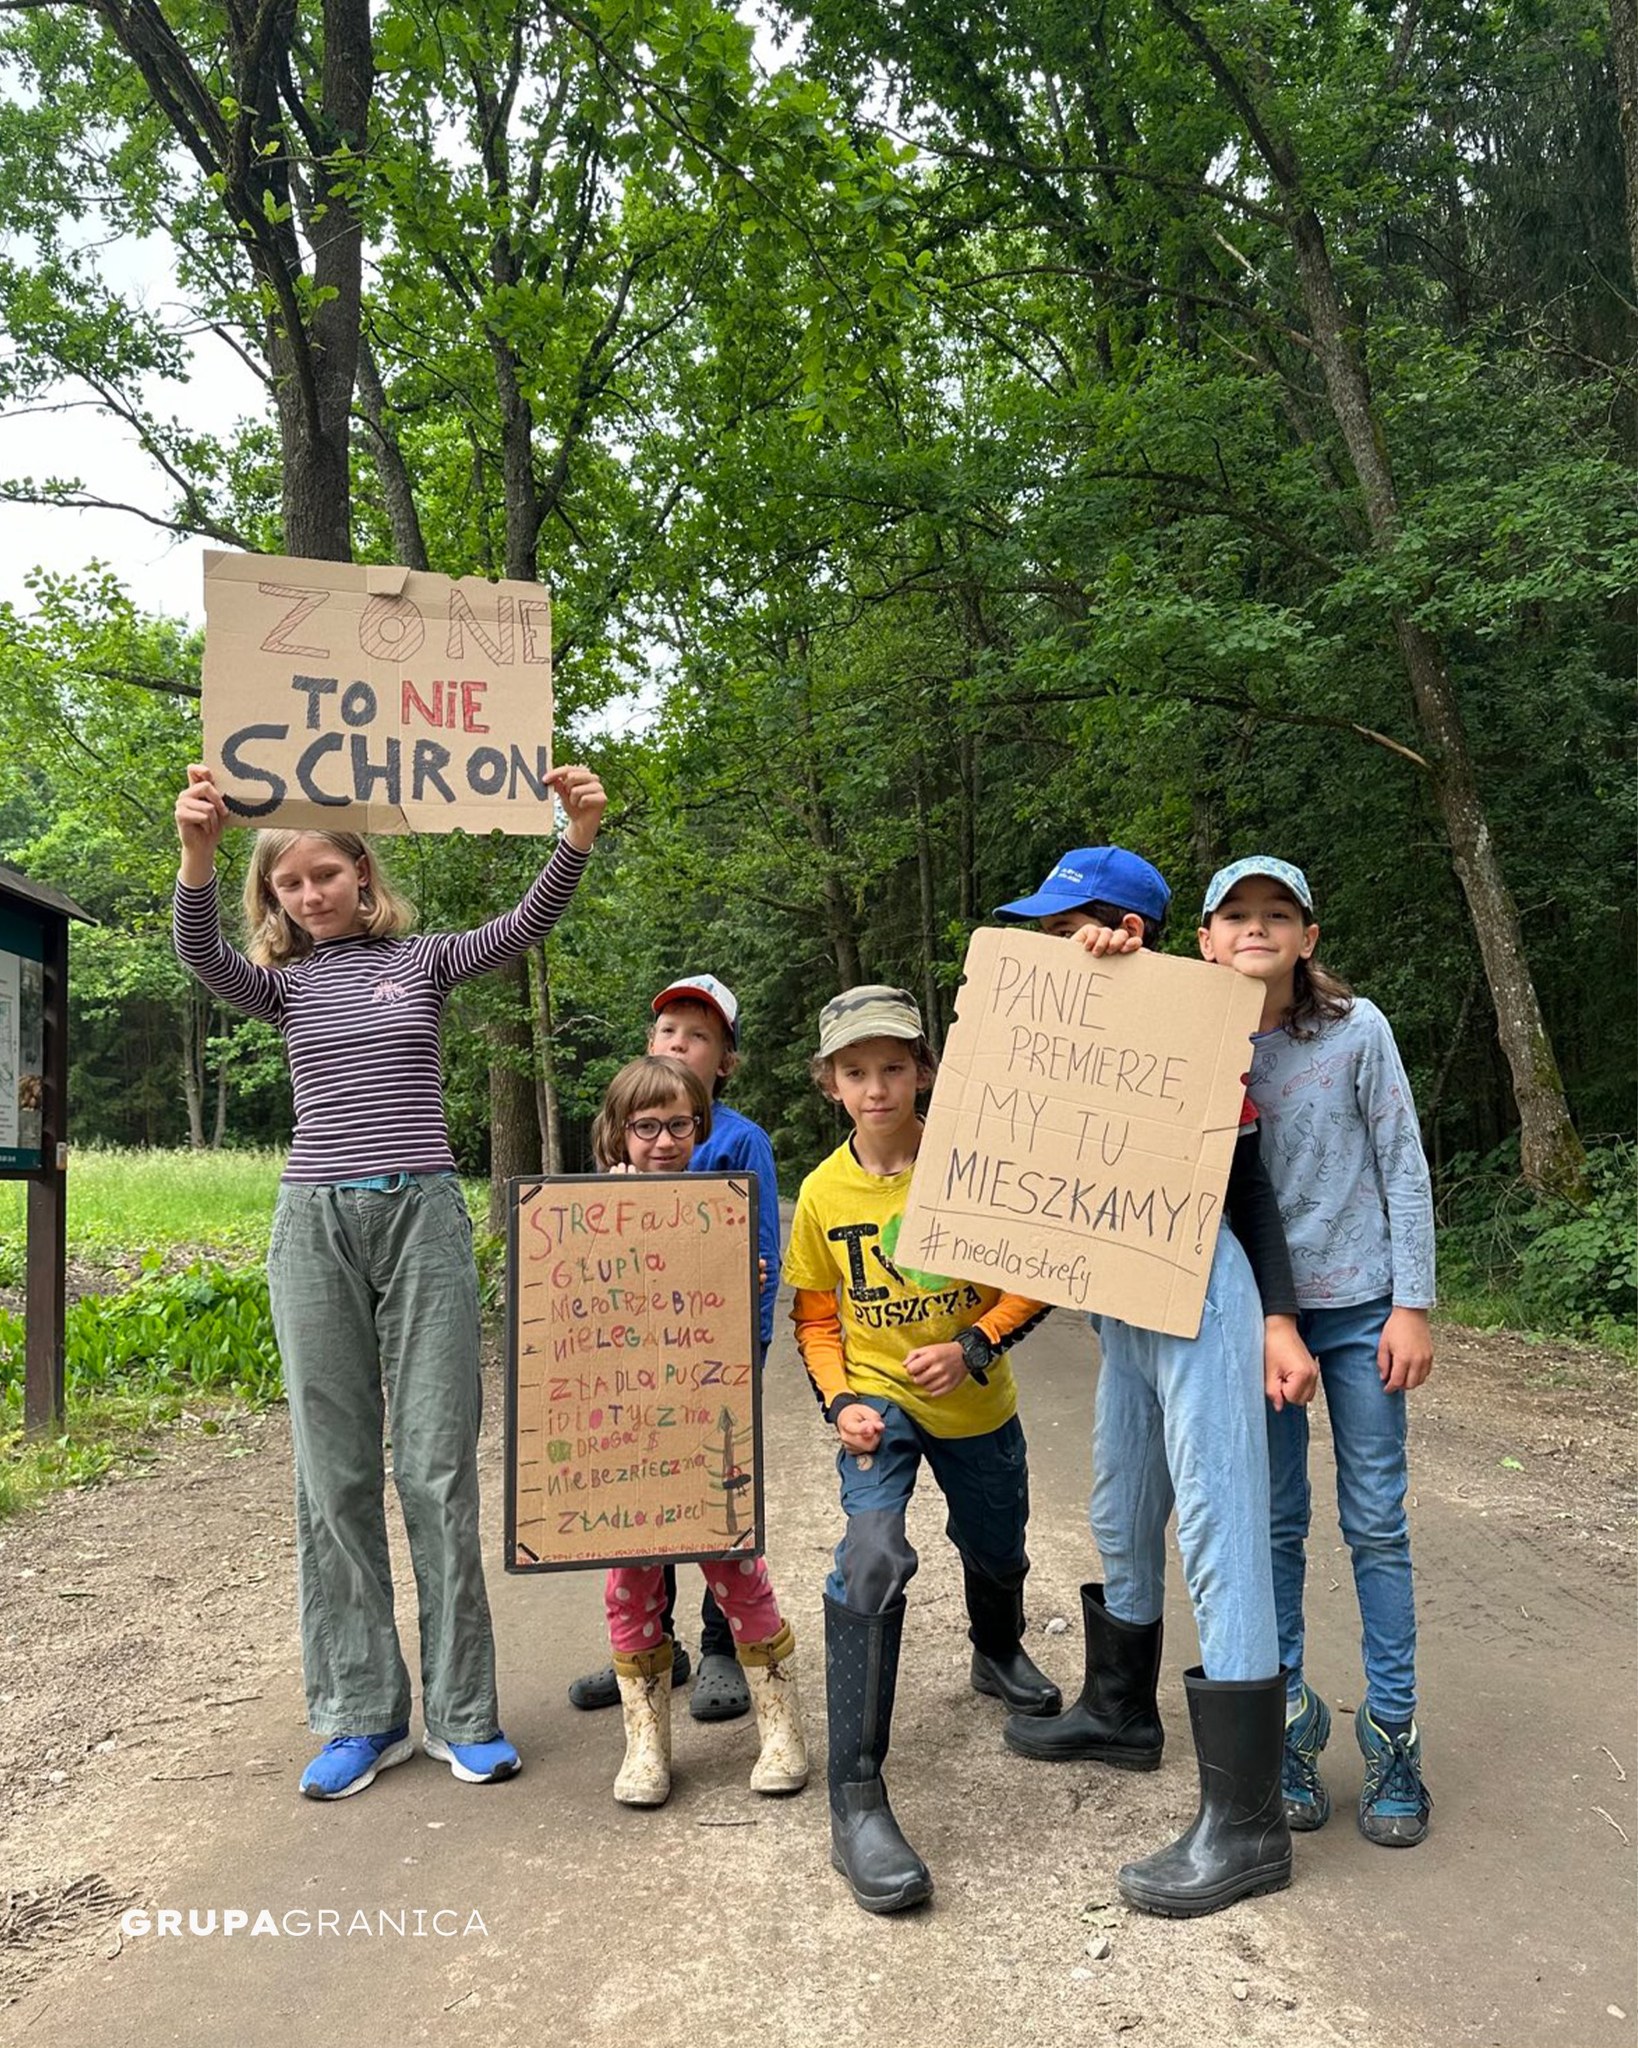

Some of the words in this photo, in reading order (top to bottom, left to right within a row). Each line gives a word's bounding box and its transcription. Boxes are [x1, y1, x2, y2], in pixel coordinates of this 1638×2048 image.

[258, 581, 551, 667] ZONE
[291, 674, 378, 731] TO
[221, 723, 552, 819] SCHRON
[992, 956, 1114, 1031] PANIE
[1006, 1025, 1189, 1114] PREMIERZE,
[975, 1082, 1049, 1154] MY
[1076, 1110, 1130, 1167] TU
[851, 1284, 982, 1329] PUSZCZA
